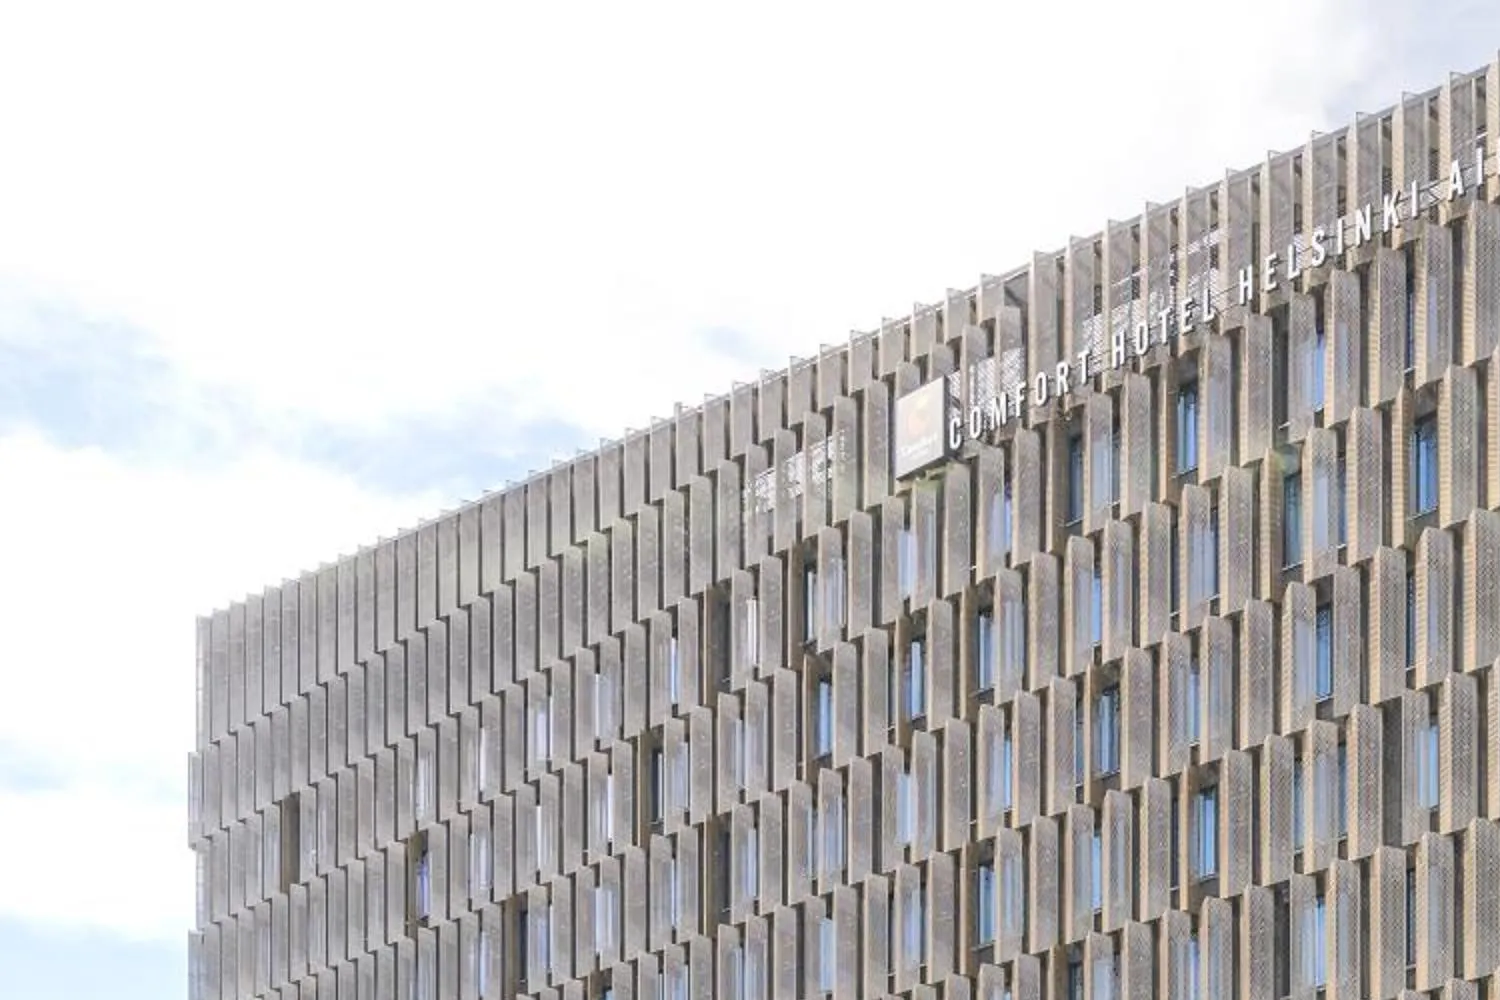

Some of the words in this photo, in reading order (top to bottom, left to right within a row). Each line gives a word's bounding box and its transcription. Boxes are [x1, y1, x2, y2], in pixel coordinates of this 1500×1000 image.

[949, 349, 1091, 449] COMFORT
[1111, 290, 1215, 368] HOTEL
[1238, 181, 1420, 305] HELSINKI
